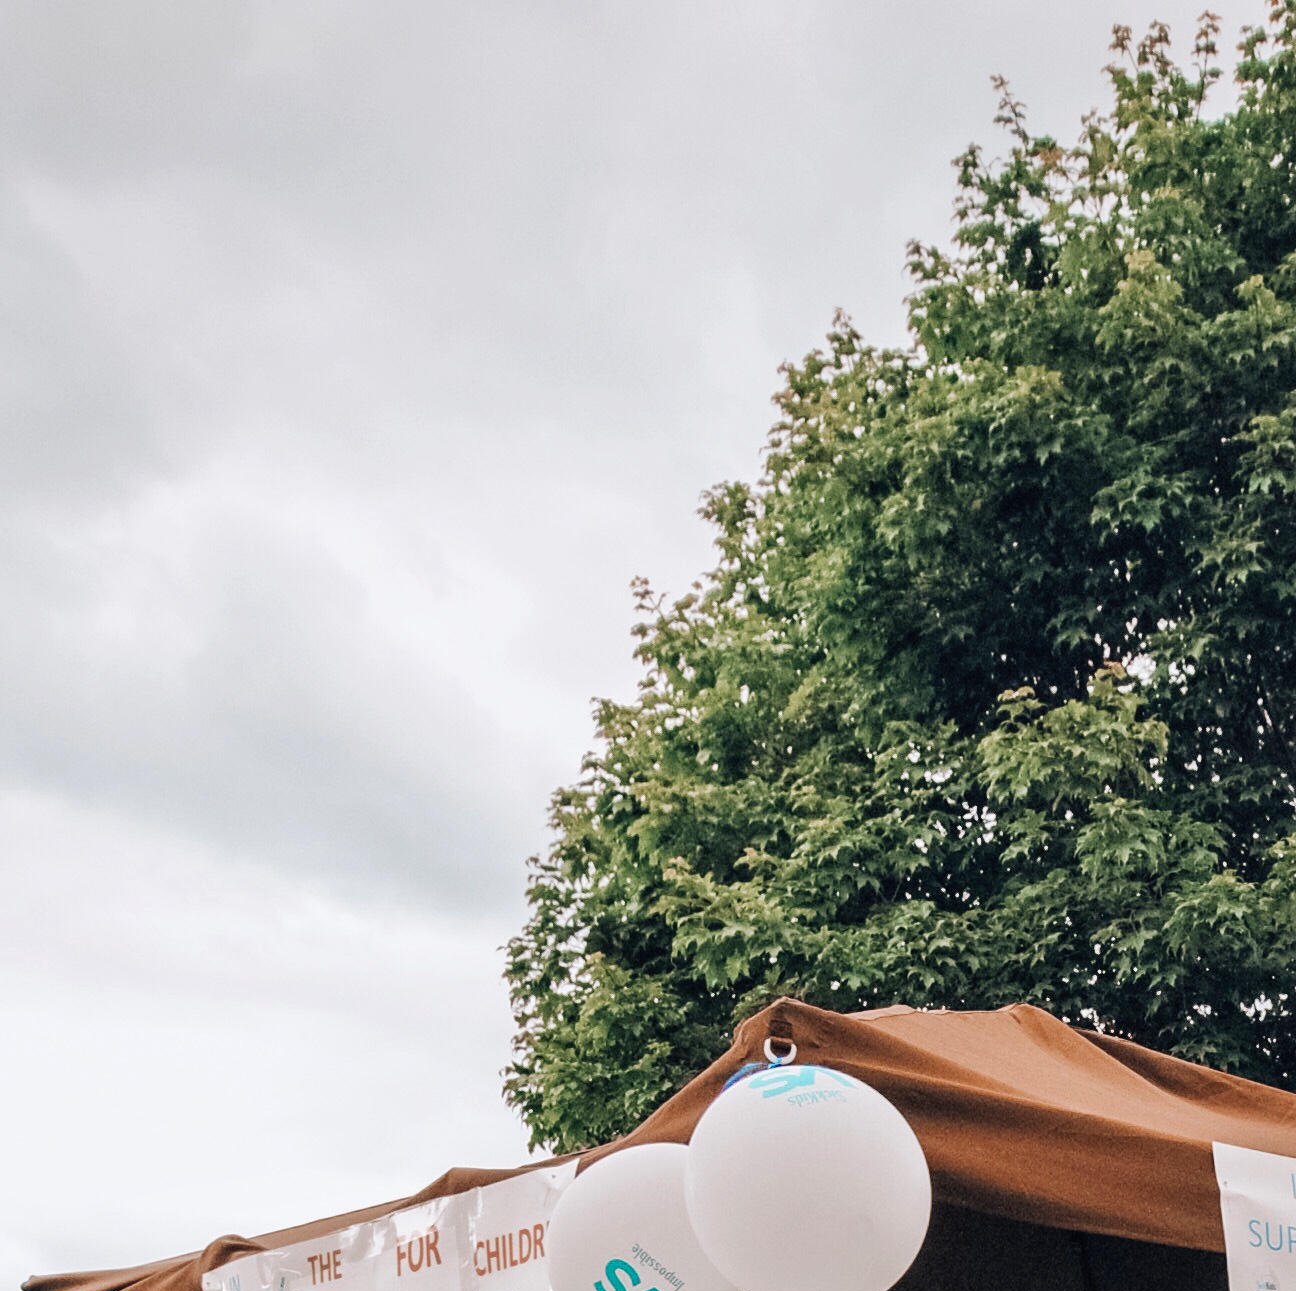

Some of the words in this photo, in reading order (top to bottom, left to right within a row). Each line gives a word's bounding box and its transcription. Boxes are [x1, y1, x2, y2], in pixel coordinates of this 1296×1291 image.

[307, 1249, 342, 1285] THE
[396, 1225, 442, 1277] FOR
[473, 1221, 549, 1277] CHILDR
